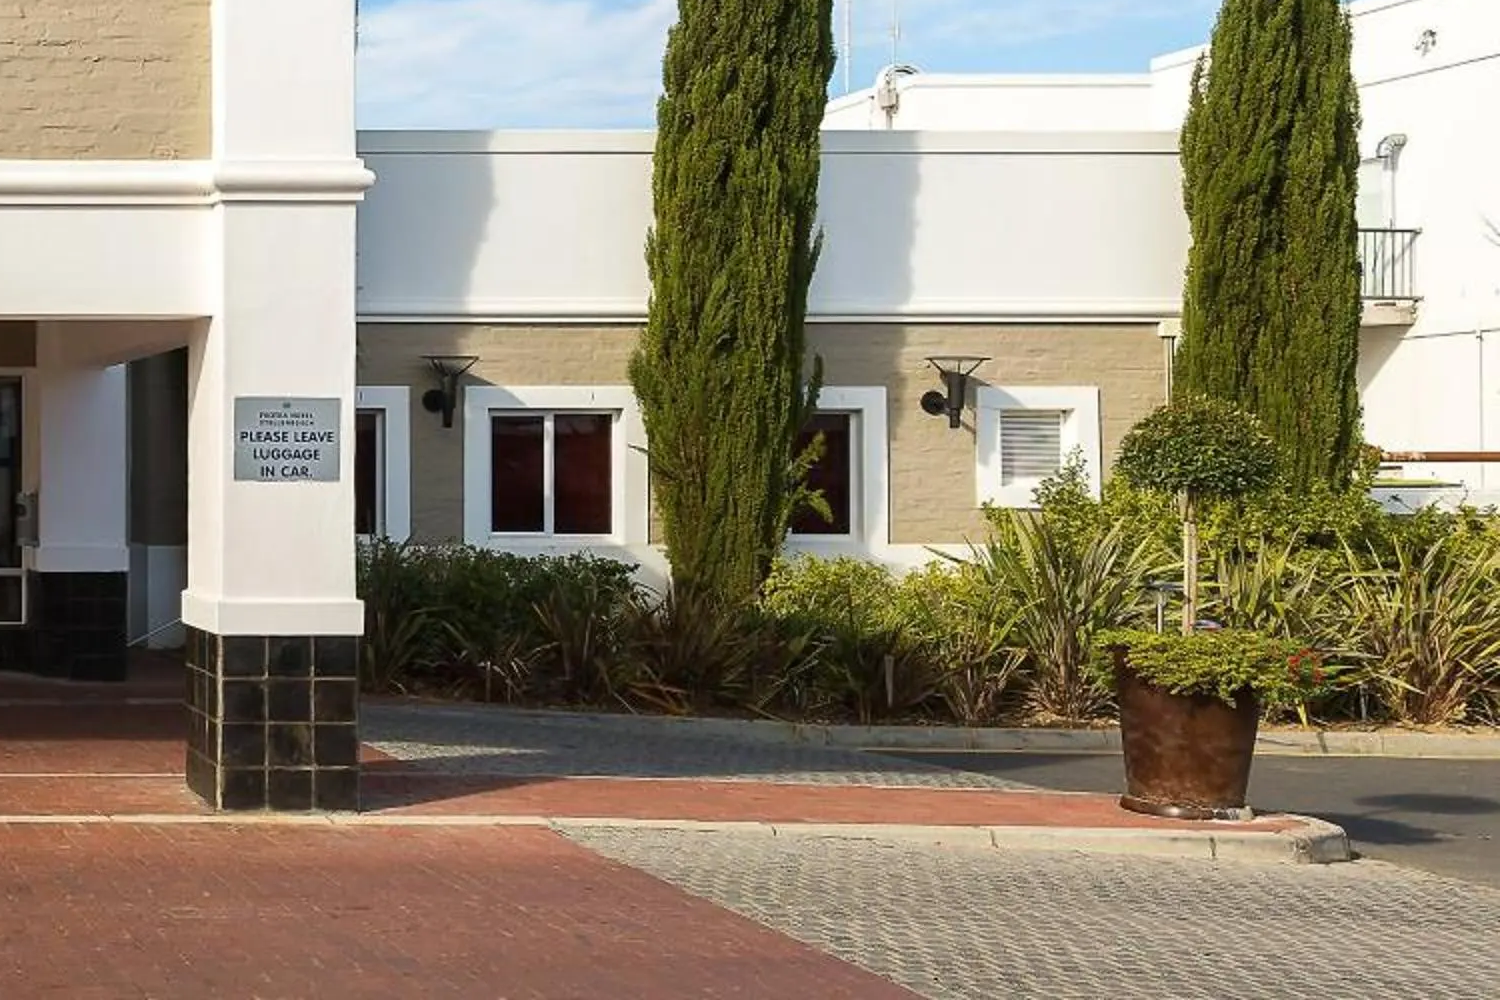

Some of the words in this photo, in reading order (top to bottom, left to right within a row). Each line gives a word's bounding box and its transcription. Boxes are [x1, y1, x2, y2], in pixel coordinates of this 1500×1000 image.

[240, 431, 289, 443] PLEASE
[293, 431, 334, 443] LEAVE
[253, 448, 320, 461] LUGGAGE
[261, 466, 275, 477] IN
[281, 466, 313, 479] CAR.
